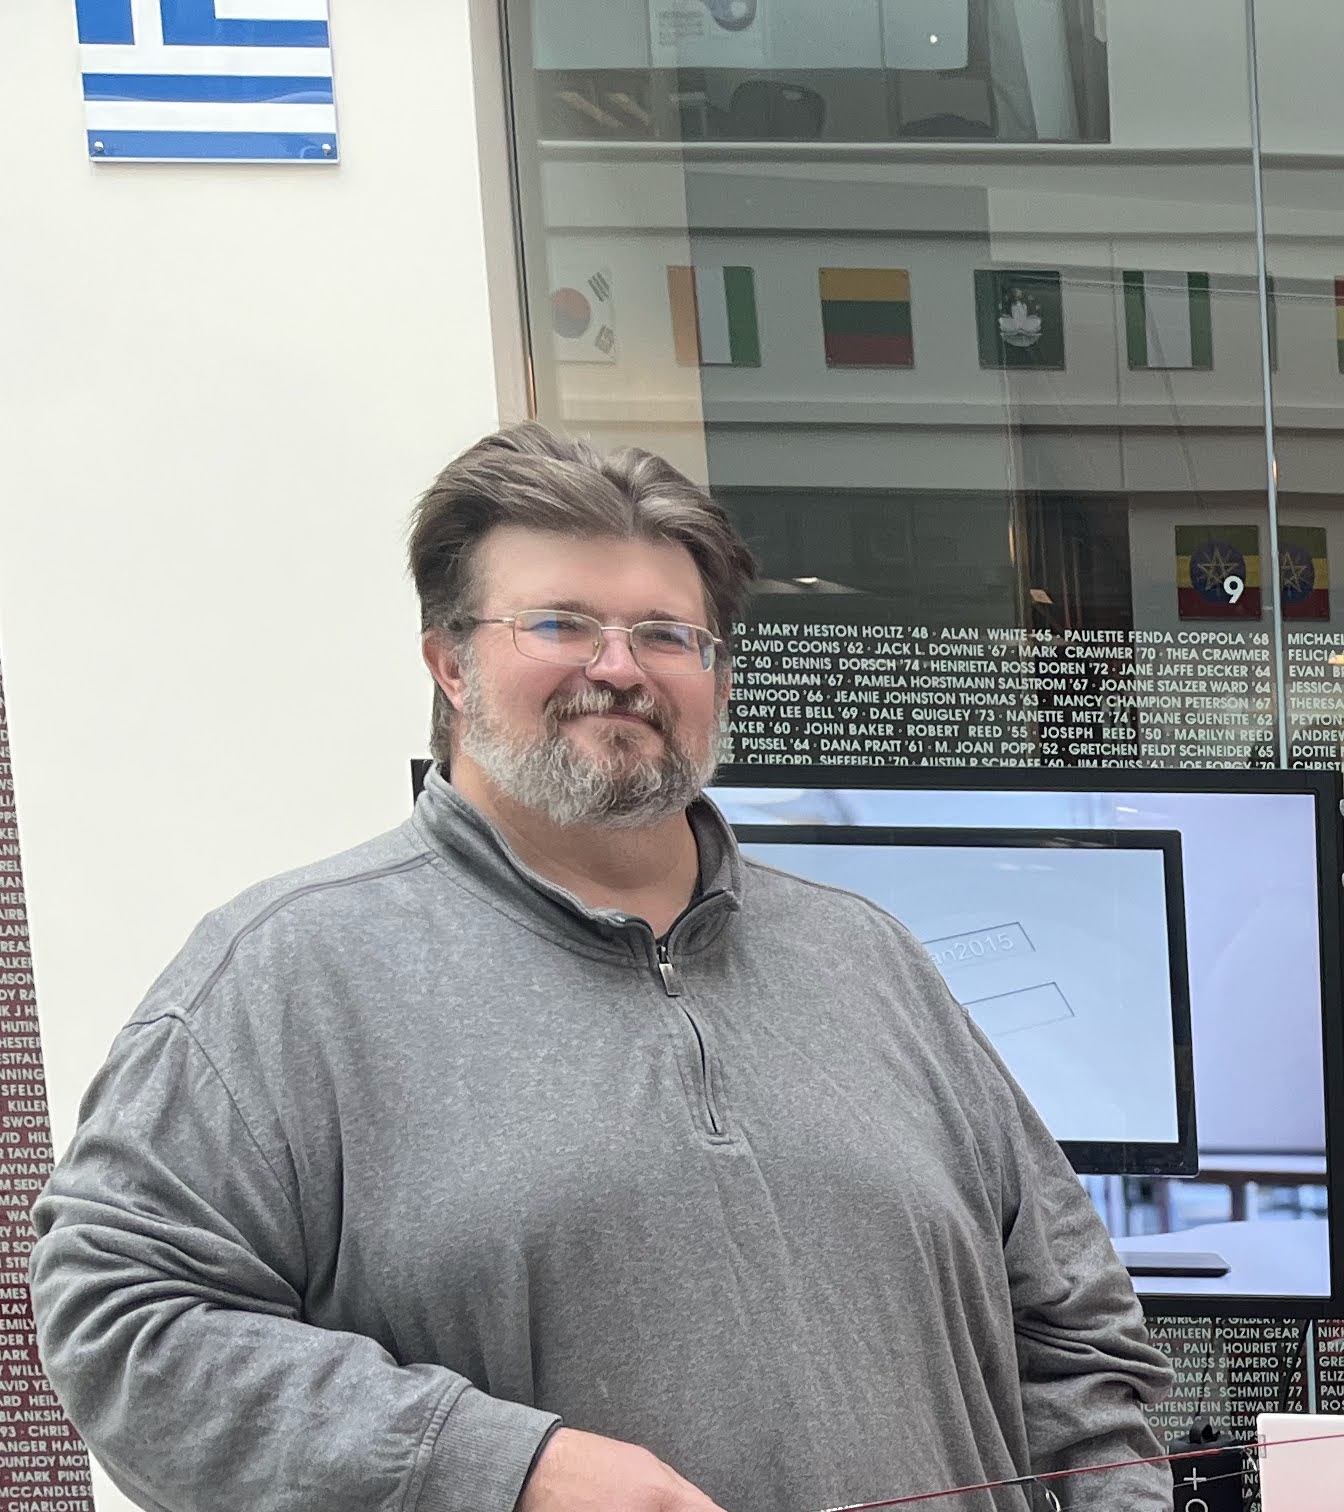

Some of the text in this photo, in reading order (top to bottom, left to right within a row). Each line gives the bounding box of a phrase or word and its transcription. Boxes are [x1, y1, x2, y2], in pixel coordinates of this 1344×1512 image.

[1224, 576, 1244, 603] 9
[758, 623, 1269, 645] MARY HESTON HOLTZ '48 ALAN WHITE '65 PAULETTE FENDA COPPOLA '68
[931, 933, 1014, 966] an2015
[8, 1501, 90, 1512] CHARLOTTE
